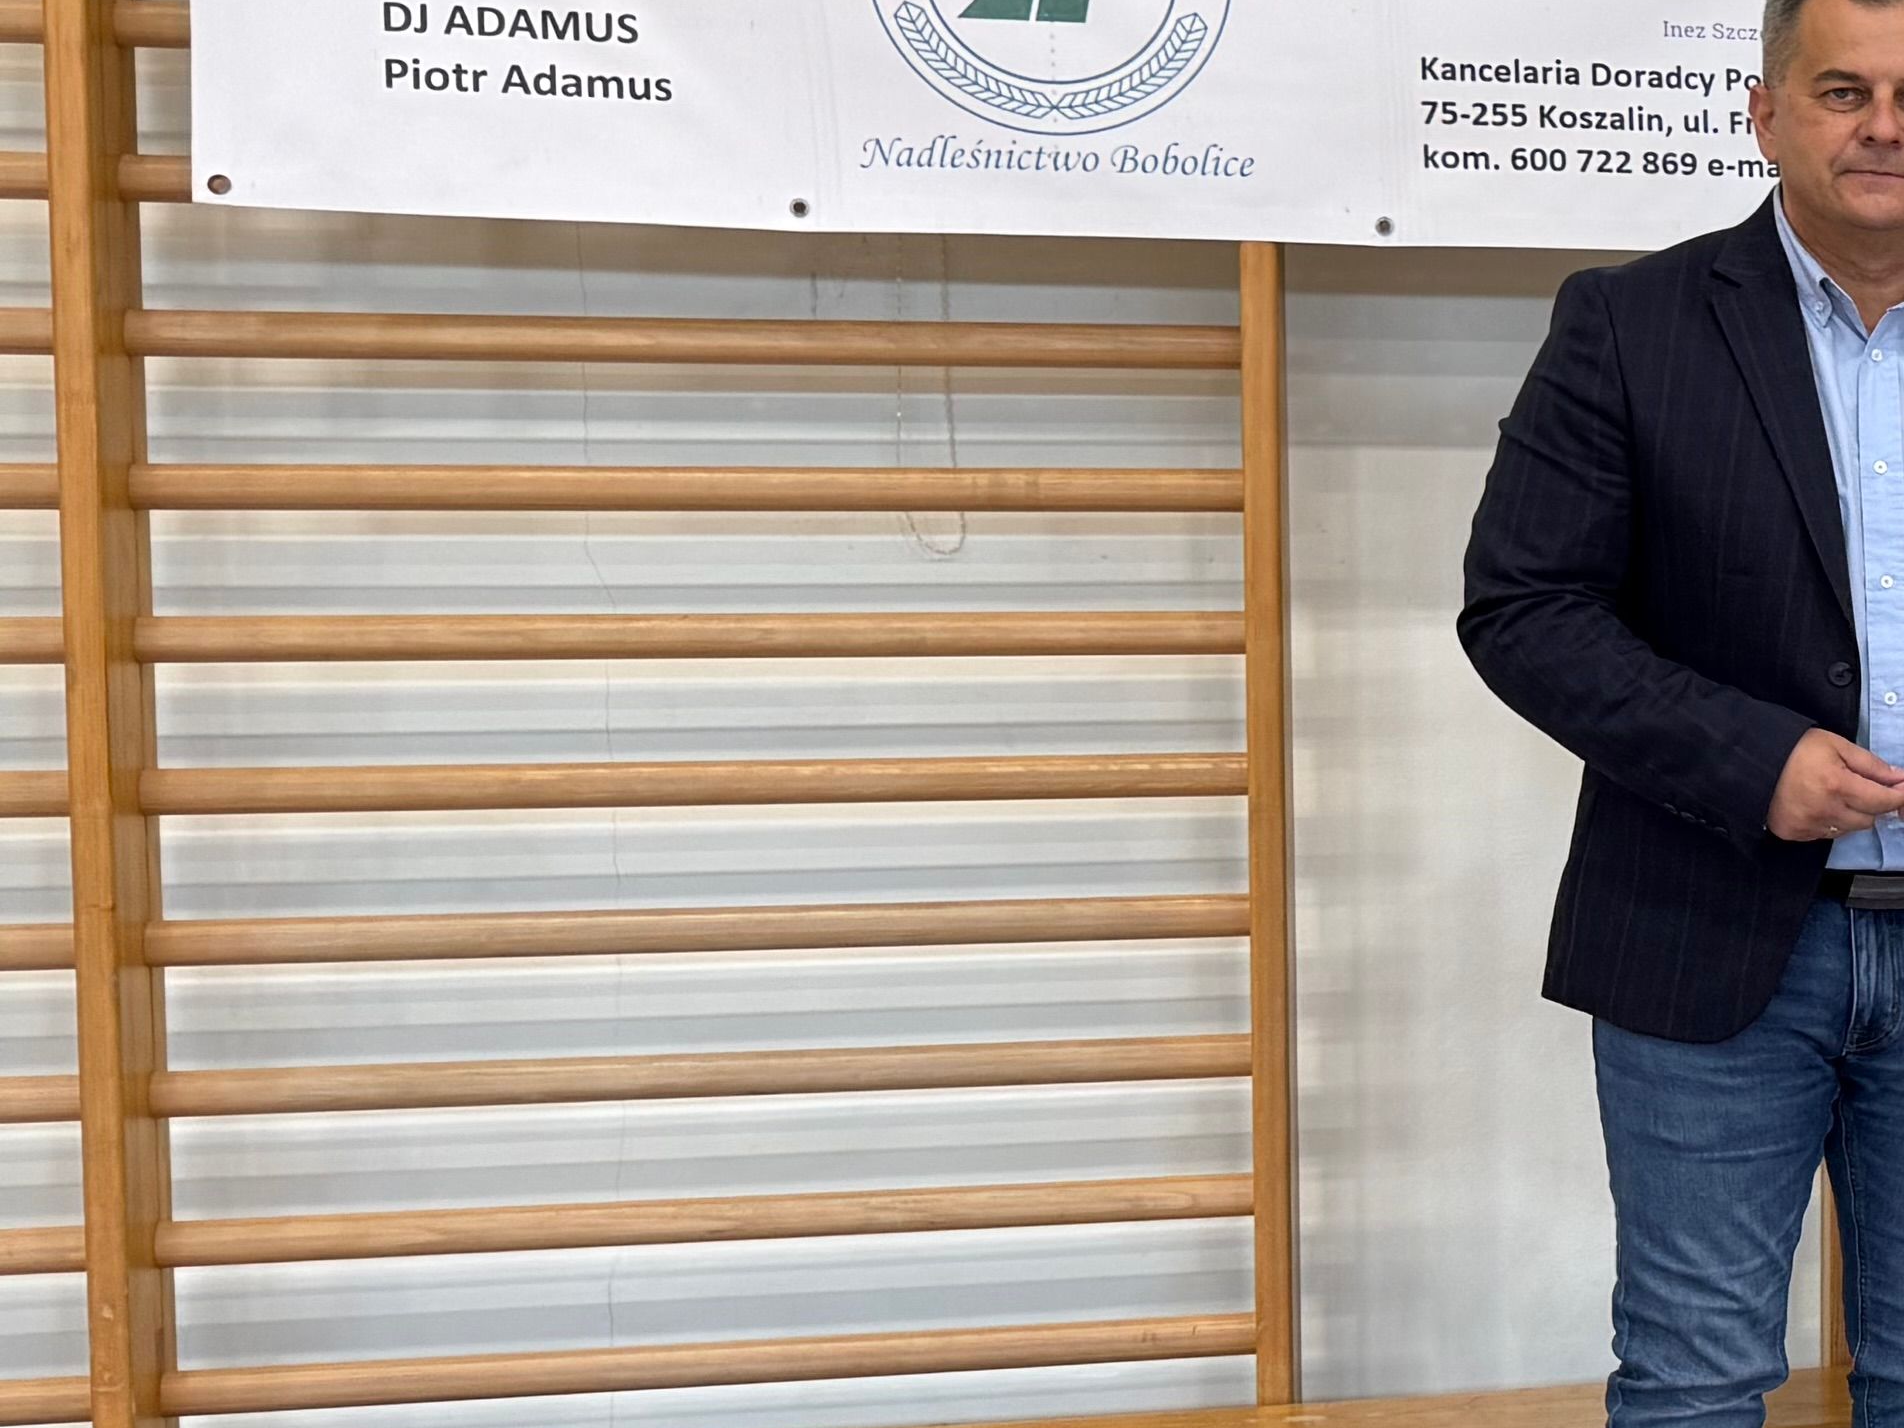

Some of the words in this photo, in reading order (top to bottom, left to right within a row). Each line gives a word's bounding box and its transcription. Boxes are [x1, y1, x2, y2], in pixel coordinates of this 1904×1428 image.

[383, 1, 428, 34] DJ
[443, 5, 639, 44] ADAMUS
[1663, 20, 1706, 39] Inez
[1712, 23, 1758, 41] Szcz
[384, 58, 488, 93] Piotr
[501, 64, 673, 102] Adamus
[1420, 56, 1580, 86] Kancelaria
[1591, 62, 1716, 98] Doradcy
[1726, 68, 1762, 92] Po
[1420, 100, 1528, 128] 75-255
[1539, 104, 1673, 138] Koszalin,
[1683, 108, 1719, 134] ul.
[1729, 110, 1753, 134] Fr
[860, 134, 1101, 174] Nadleśnictwo
[1111, 143, 1256, 178] Bobolice
[1423, 143, 1500, 171] kom.
[1510, 147, 1567, 172] 600
[1576, 149, 1633, 174] 722
[1642, 151, 1698, 176] 869
[1708, 158, 1780, 178] e-ma
